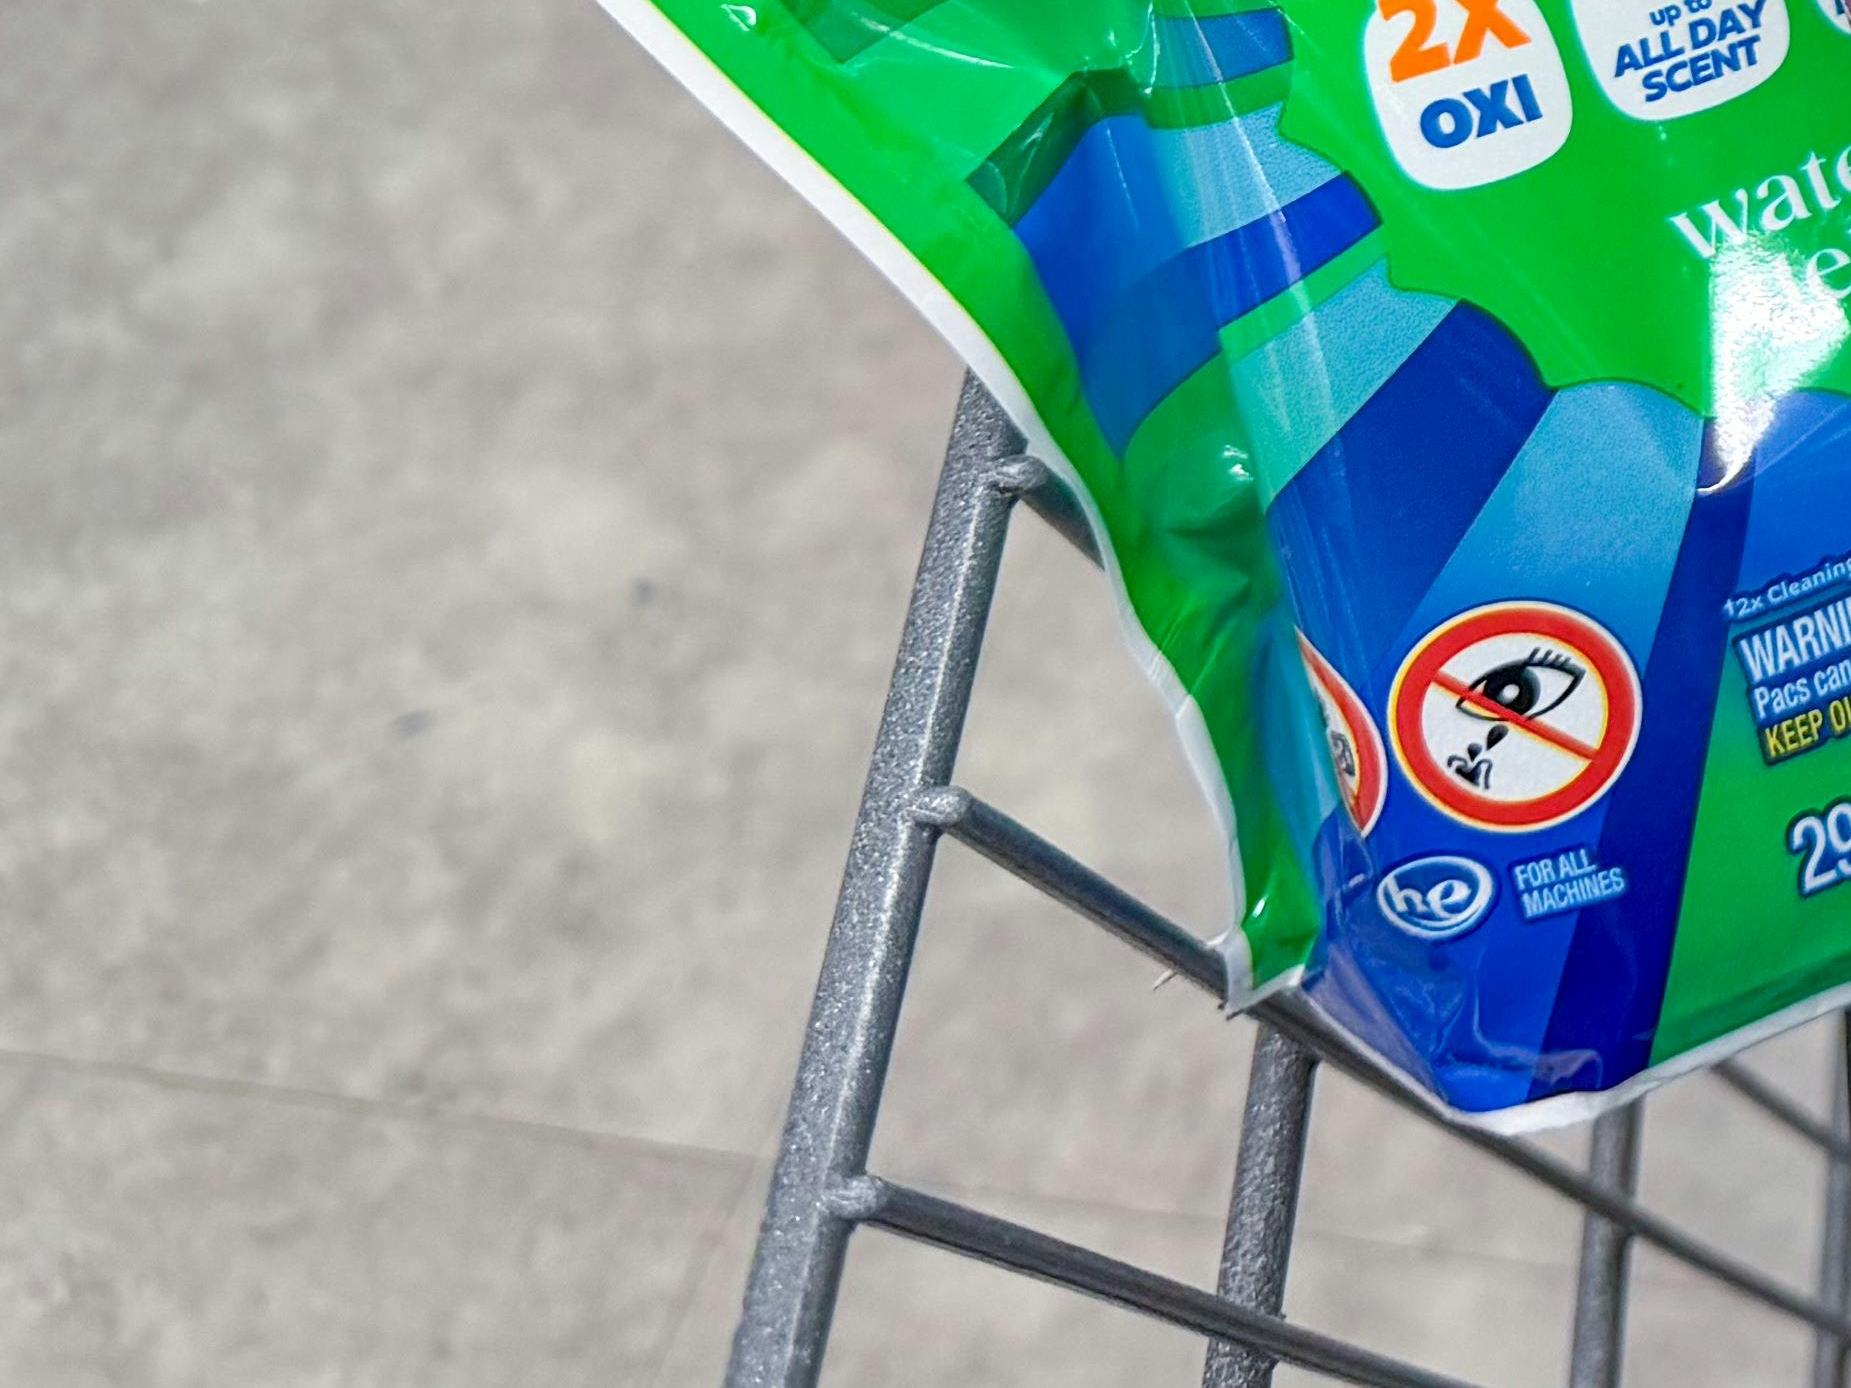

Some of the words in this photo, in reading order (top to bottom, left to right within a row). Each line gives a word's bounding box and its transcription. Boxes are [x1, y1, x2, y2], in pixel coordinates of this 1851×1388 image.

[1649, 4, 1682, 27] up
[1613, 30, 1686, 79] ALL
[1641, 34, 1761, 103] SCENT
[1418, 72, 1543, 150] OXI
[1753, 677, 1811, 720] Pacs
[1764, 708, 1823, 759] KEEP
[1513, 857, 1557, 891] FOR
[1557, 848, 1599, 878] ALL
[1521, 867, 1627, 920] MACHINES
